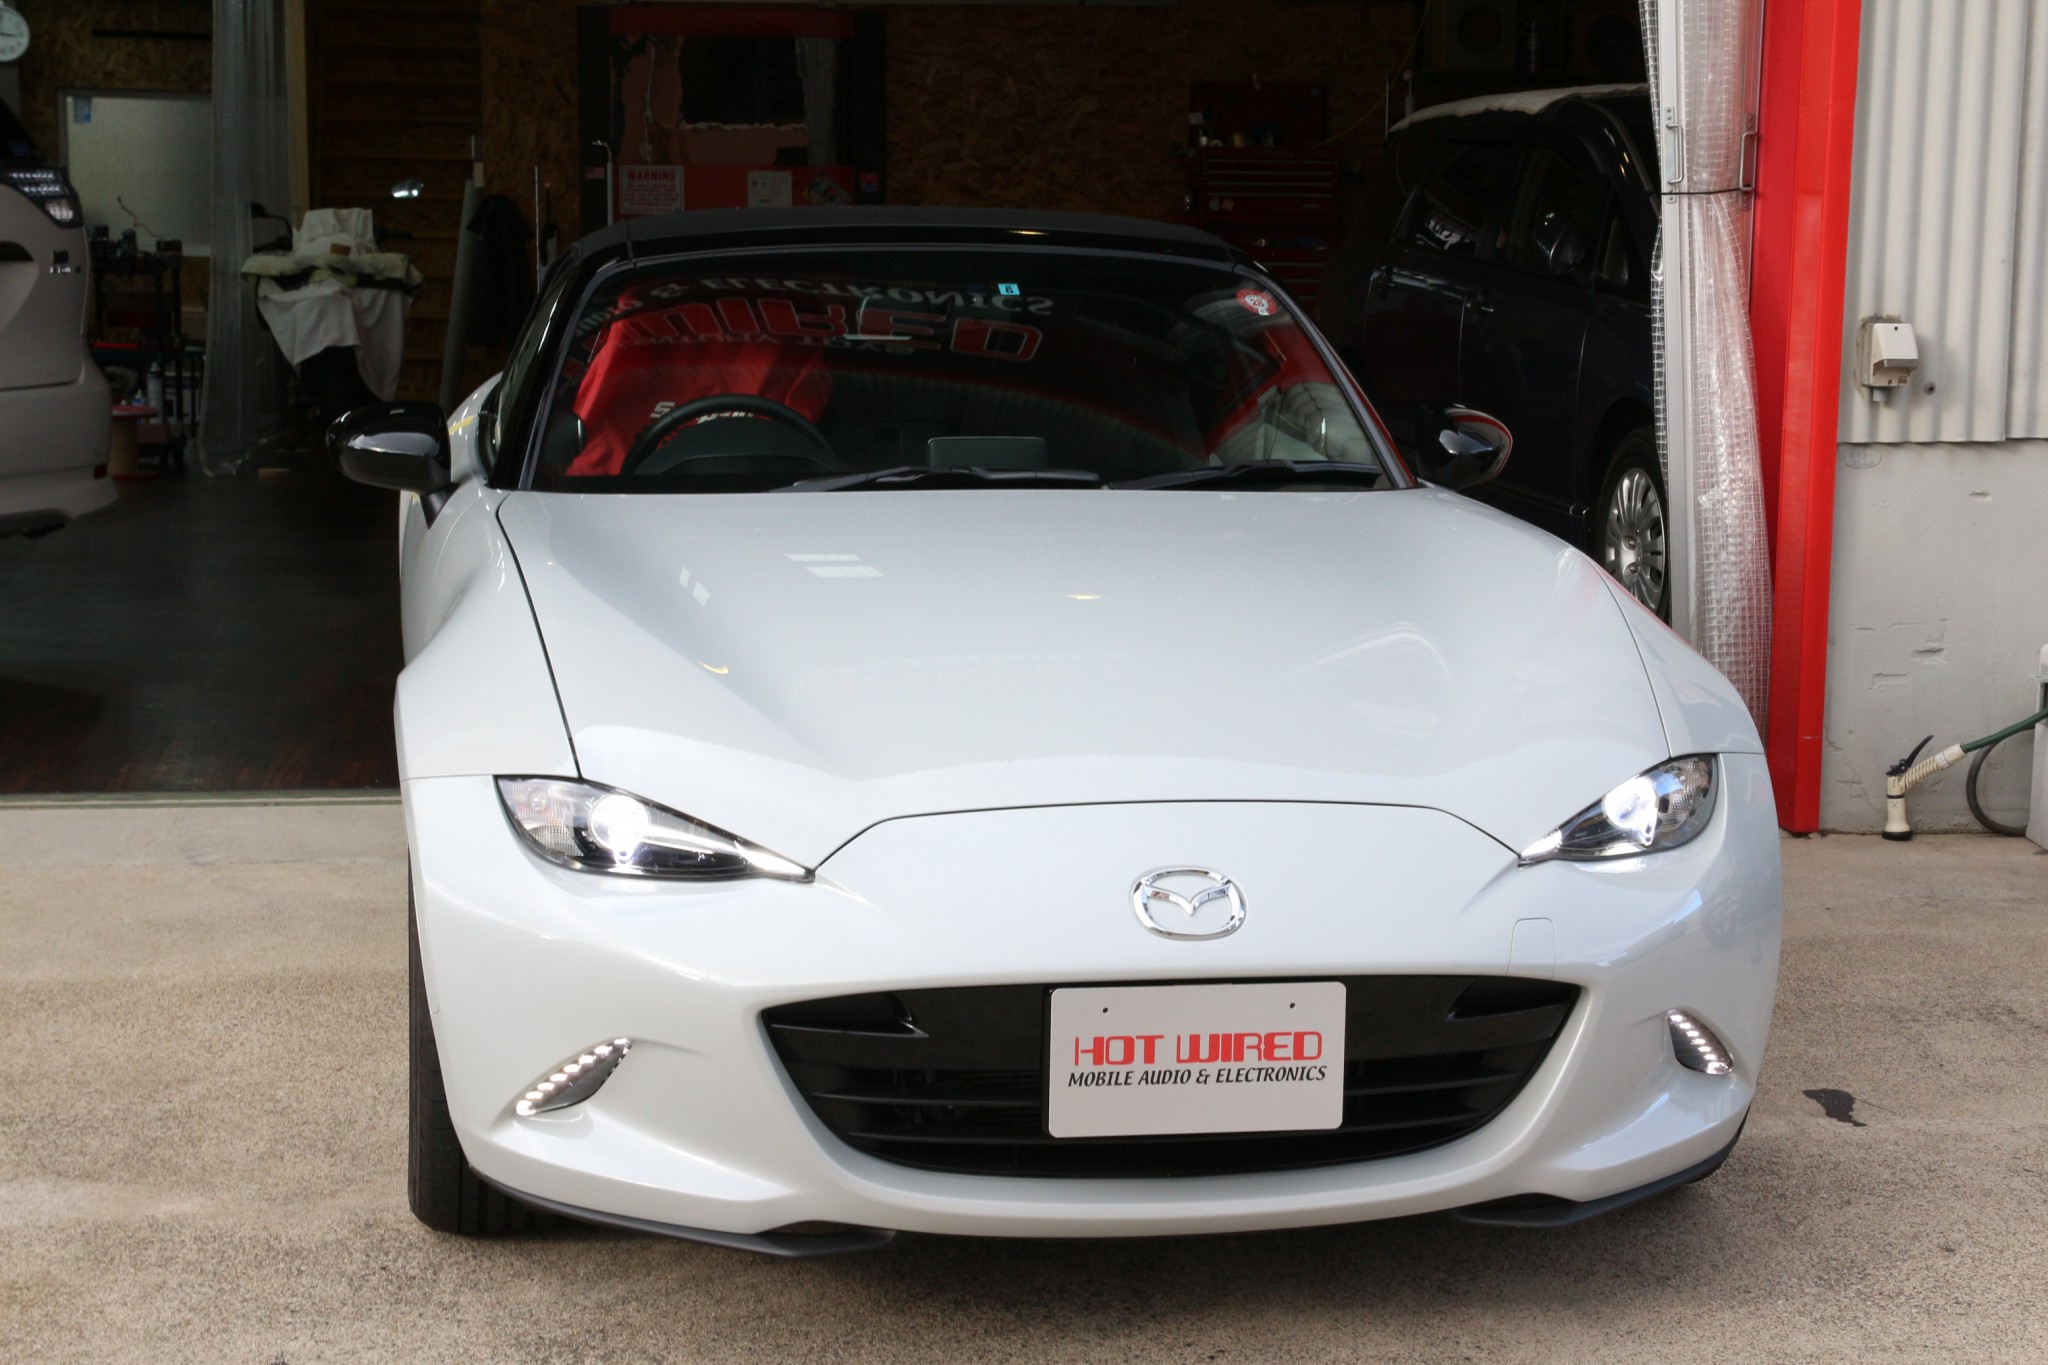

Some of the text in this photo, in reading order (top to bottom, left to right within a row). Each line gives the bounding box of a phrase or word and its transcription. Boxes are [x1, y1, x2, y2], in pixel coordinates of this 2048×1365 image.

[627, 170, 676, 182] WARNING
[1074, 1031, 1323, 1066] HOT WIRED
[1068, 1065, 1328, 1087] MOBILE AUDIO & ELECTRONICS
